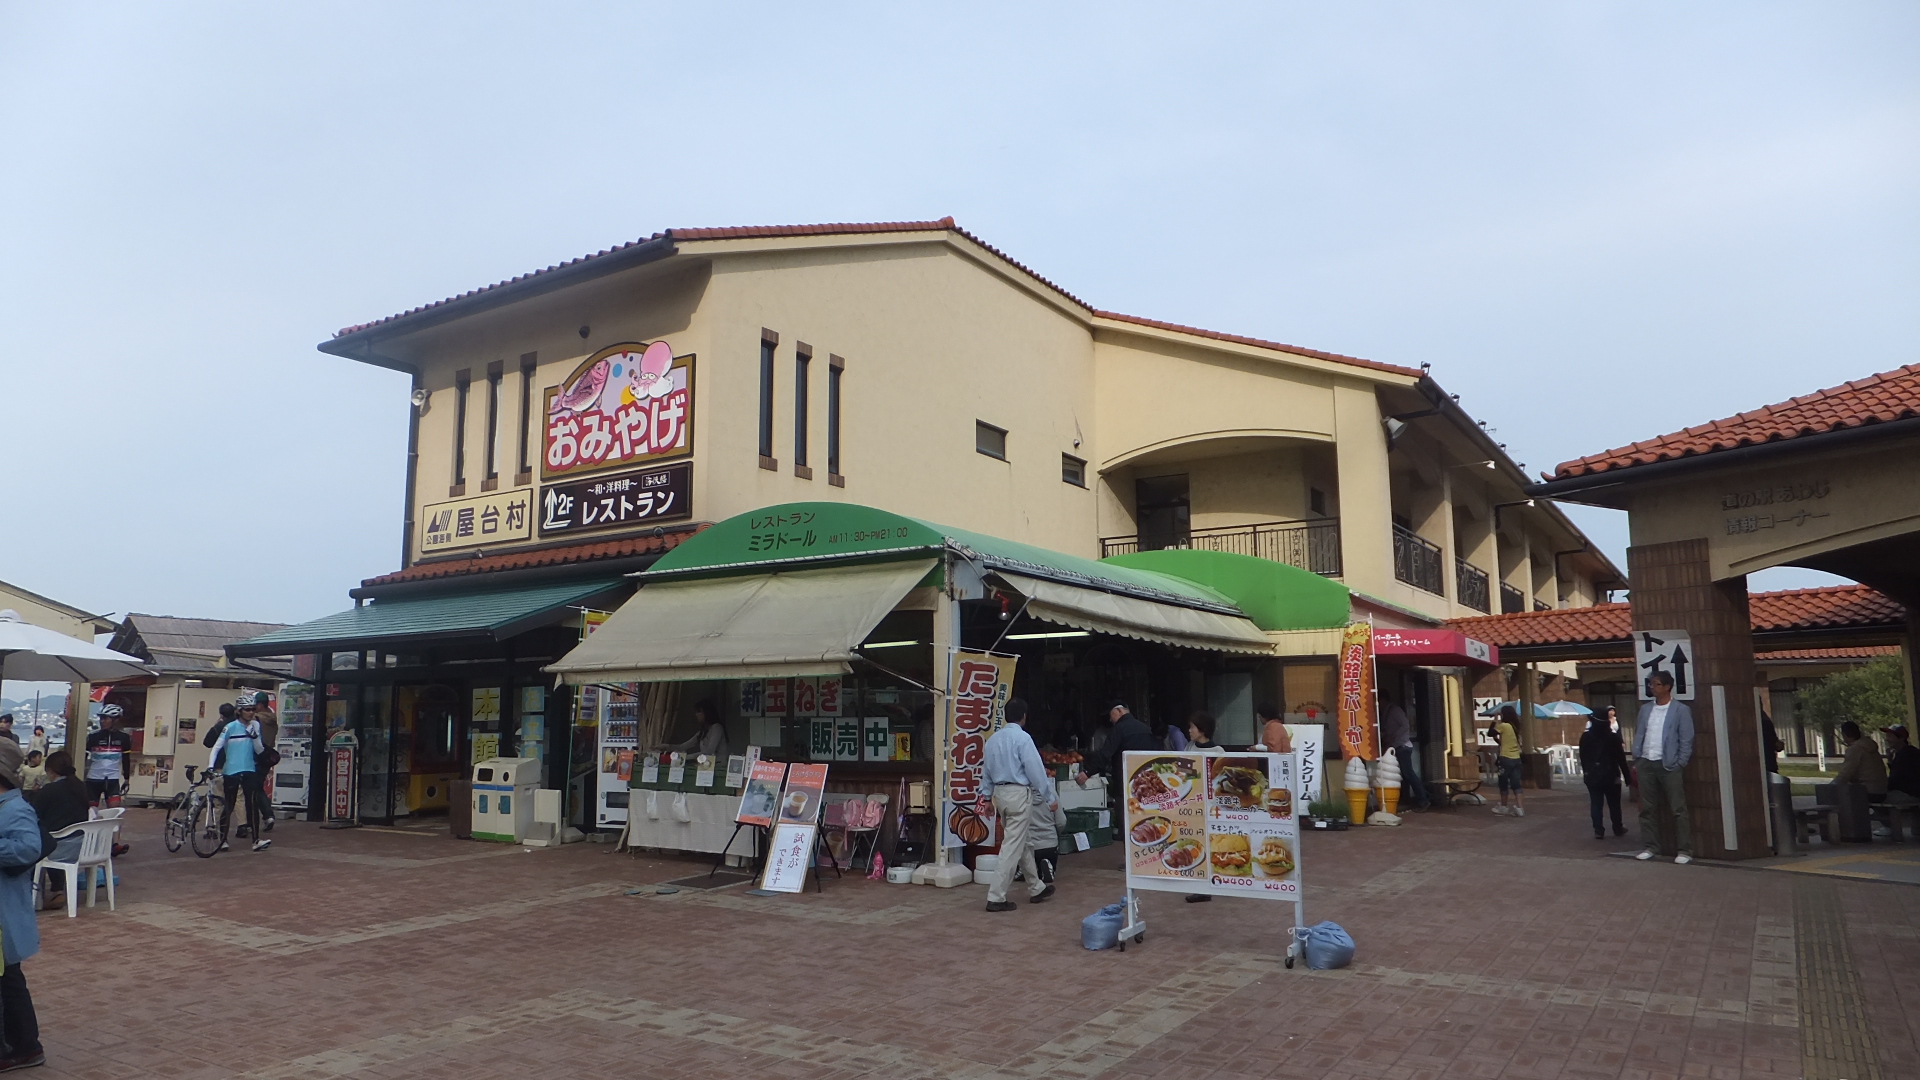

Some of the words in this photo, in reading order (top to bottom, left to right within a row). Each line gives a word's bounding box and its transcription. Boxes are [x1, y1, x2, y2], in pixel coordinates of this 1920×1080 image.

[547, 392, 687, 467] おみやげ
[456, 499, 527, 538] 屋台村
[557, 493, 574, 516] 2F
[582, 491, 675, 525] レストラン
[750, 512, 816, 530] レストラン
[1726, 509, 1830, 535] 情報コーナー
[748, 529, 817, 552] ミラドール
[1382, 639, 1431, 648] ソフトクリーム
[741, 678, 841, 713] 新玉ねぎ
[1343, 644, 1363, 754] 淡路牛バーガー
[811, 722, 888, 757] 販売中
[950, 660, 997, 806] たまねぎ
[1300, 741, 1316, 801] ソフトクリーム
[787, 832, 805, 868] 試食が
